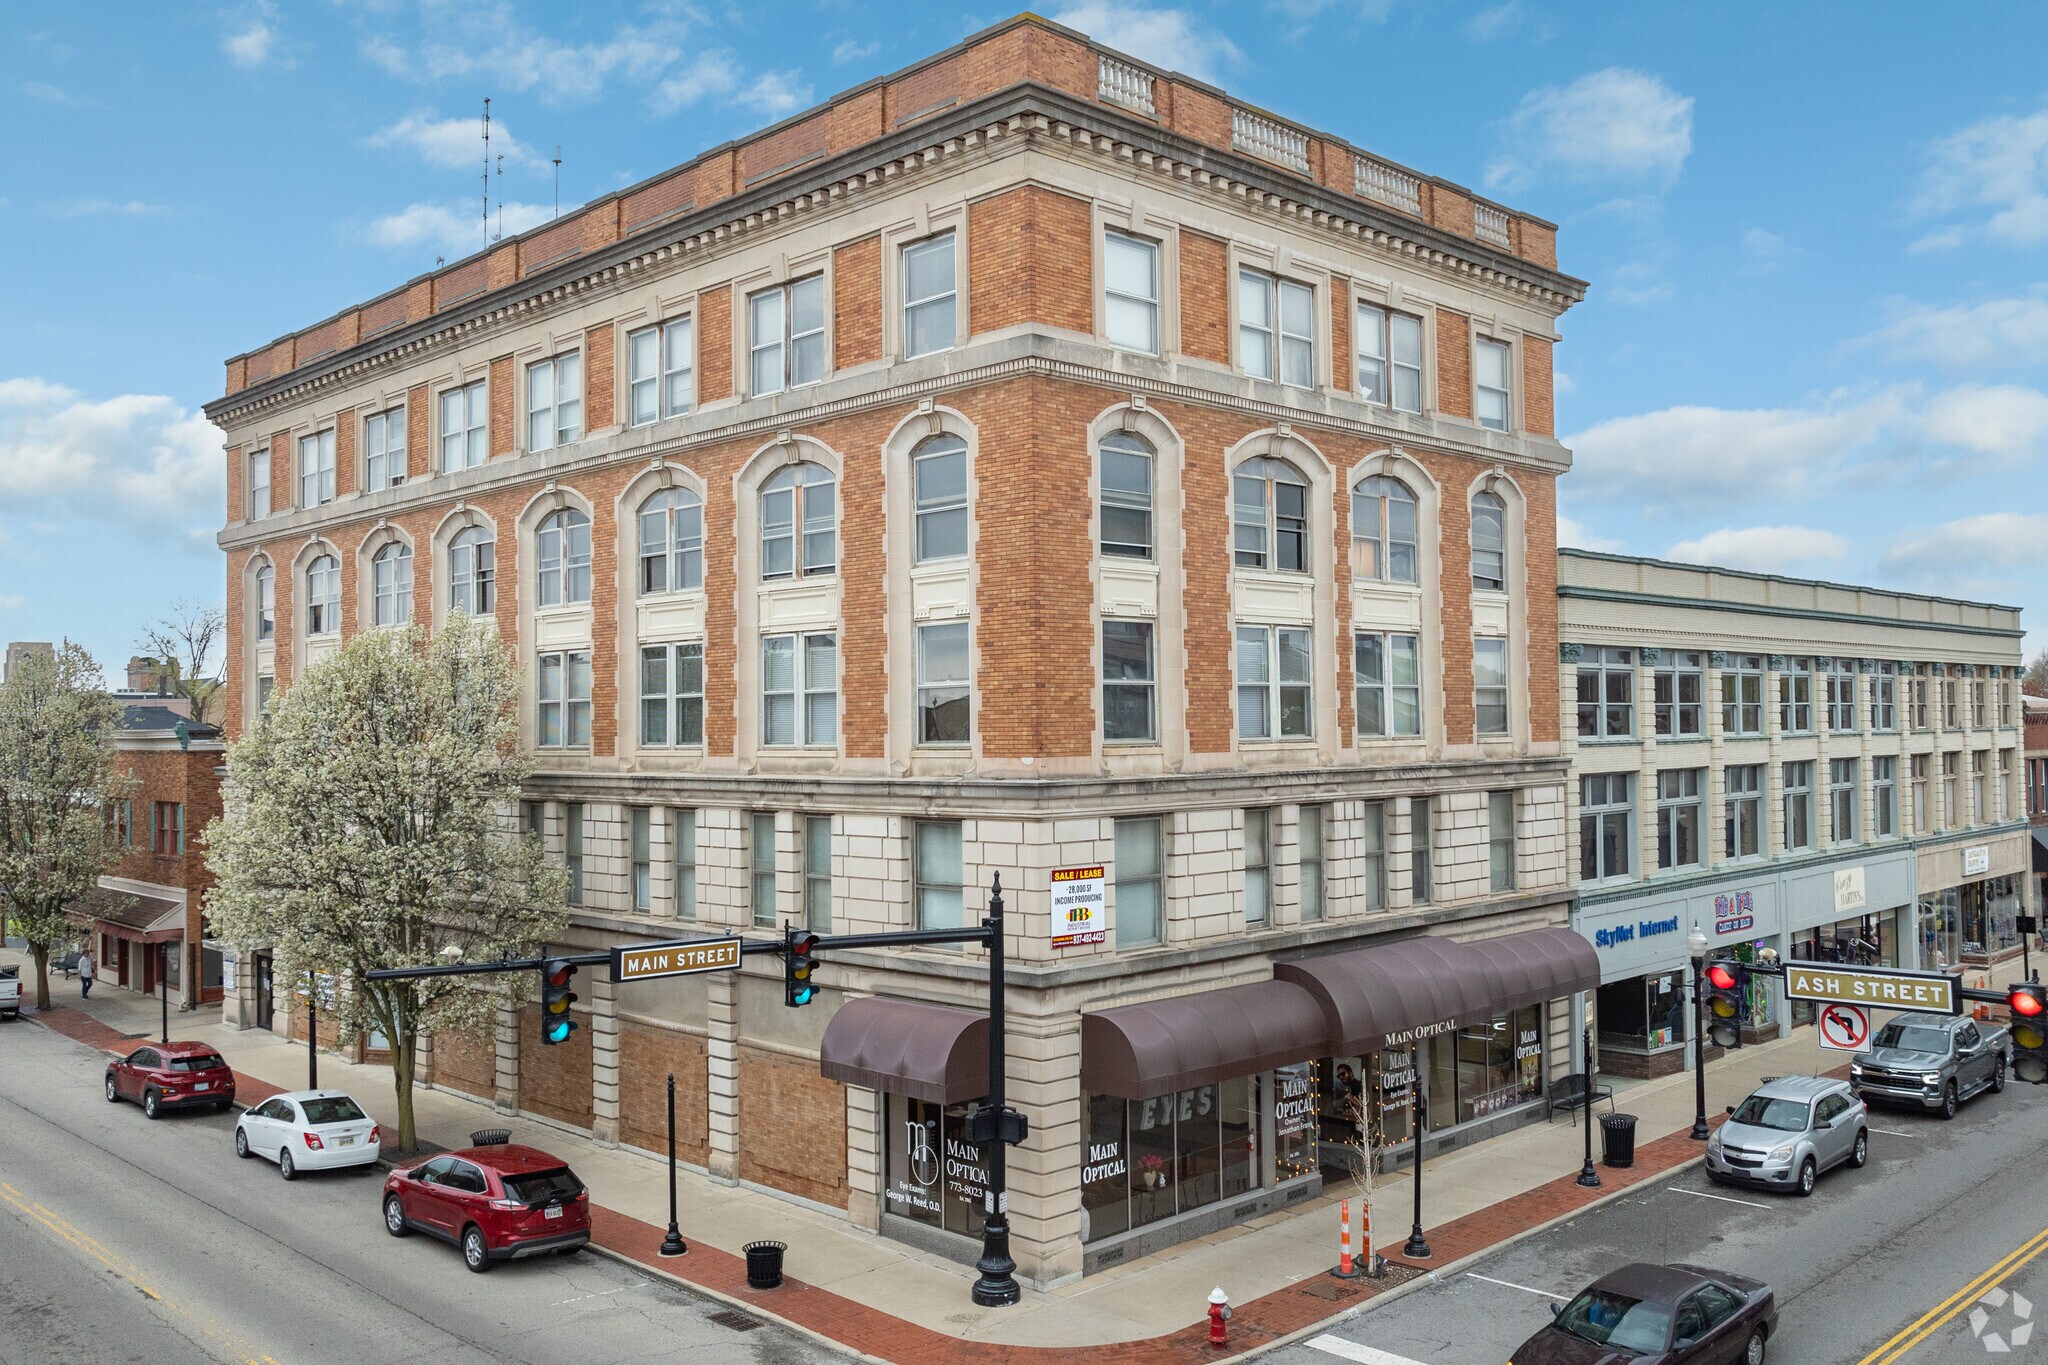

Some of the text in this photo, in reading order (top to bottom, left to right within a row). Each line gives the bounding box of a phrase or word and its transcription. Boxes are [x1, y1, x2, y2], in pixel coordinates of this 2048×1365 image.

[1054, 871, 1075, 881] SALE
[1080, 869, 1102, 879] LEASE
[1087, 884, 1092, 892] SF
[1055, 893, 1102, 905] INCOME PRODUCING
[1073, 932, 1104, 945] 937-492-4423
[1596, 915, 1678, 948] SkyNet Internet
[628, 947, 735, 973] MAIN STREET
[1796, 976, 1943, 1003] ASH STREET
[1385, 1019, 1457, 1047] MAIN OPTICAL
[1521, 1030, 1537, 1044] MAIN
[1389, 1052, 1411, 1070] MAIN
[1517, 1043, 1541, 1060] OPTICAL
[1383, 1069, 1417, 1089] OPTICAL
[1283, 1080, 1308, 1098] MAIN
[1140, 1086, 1212, 1130] EYES
[1275, 1098, 1314, 1119] OPTICAL
[1278, 1121, 1313, 1136] Jonathan Frank
[947, 1139, 979, 1162] MAIN
[1090, 1142, 1118, 1163] MAIN
[1083, 1159, 1126, 1184] OPTICAL
[899, 1181, 927, 1195] Eye Exams:
[949, 1181, 983, 1197] 773-8023
[886, 1189, 941, 1212] George W. Reed, O.D.
